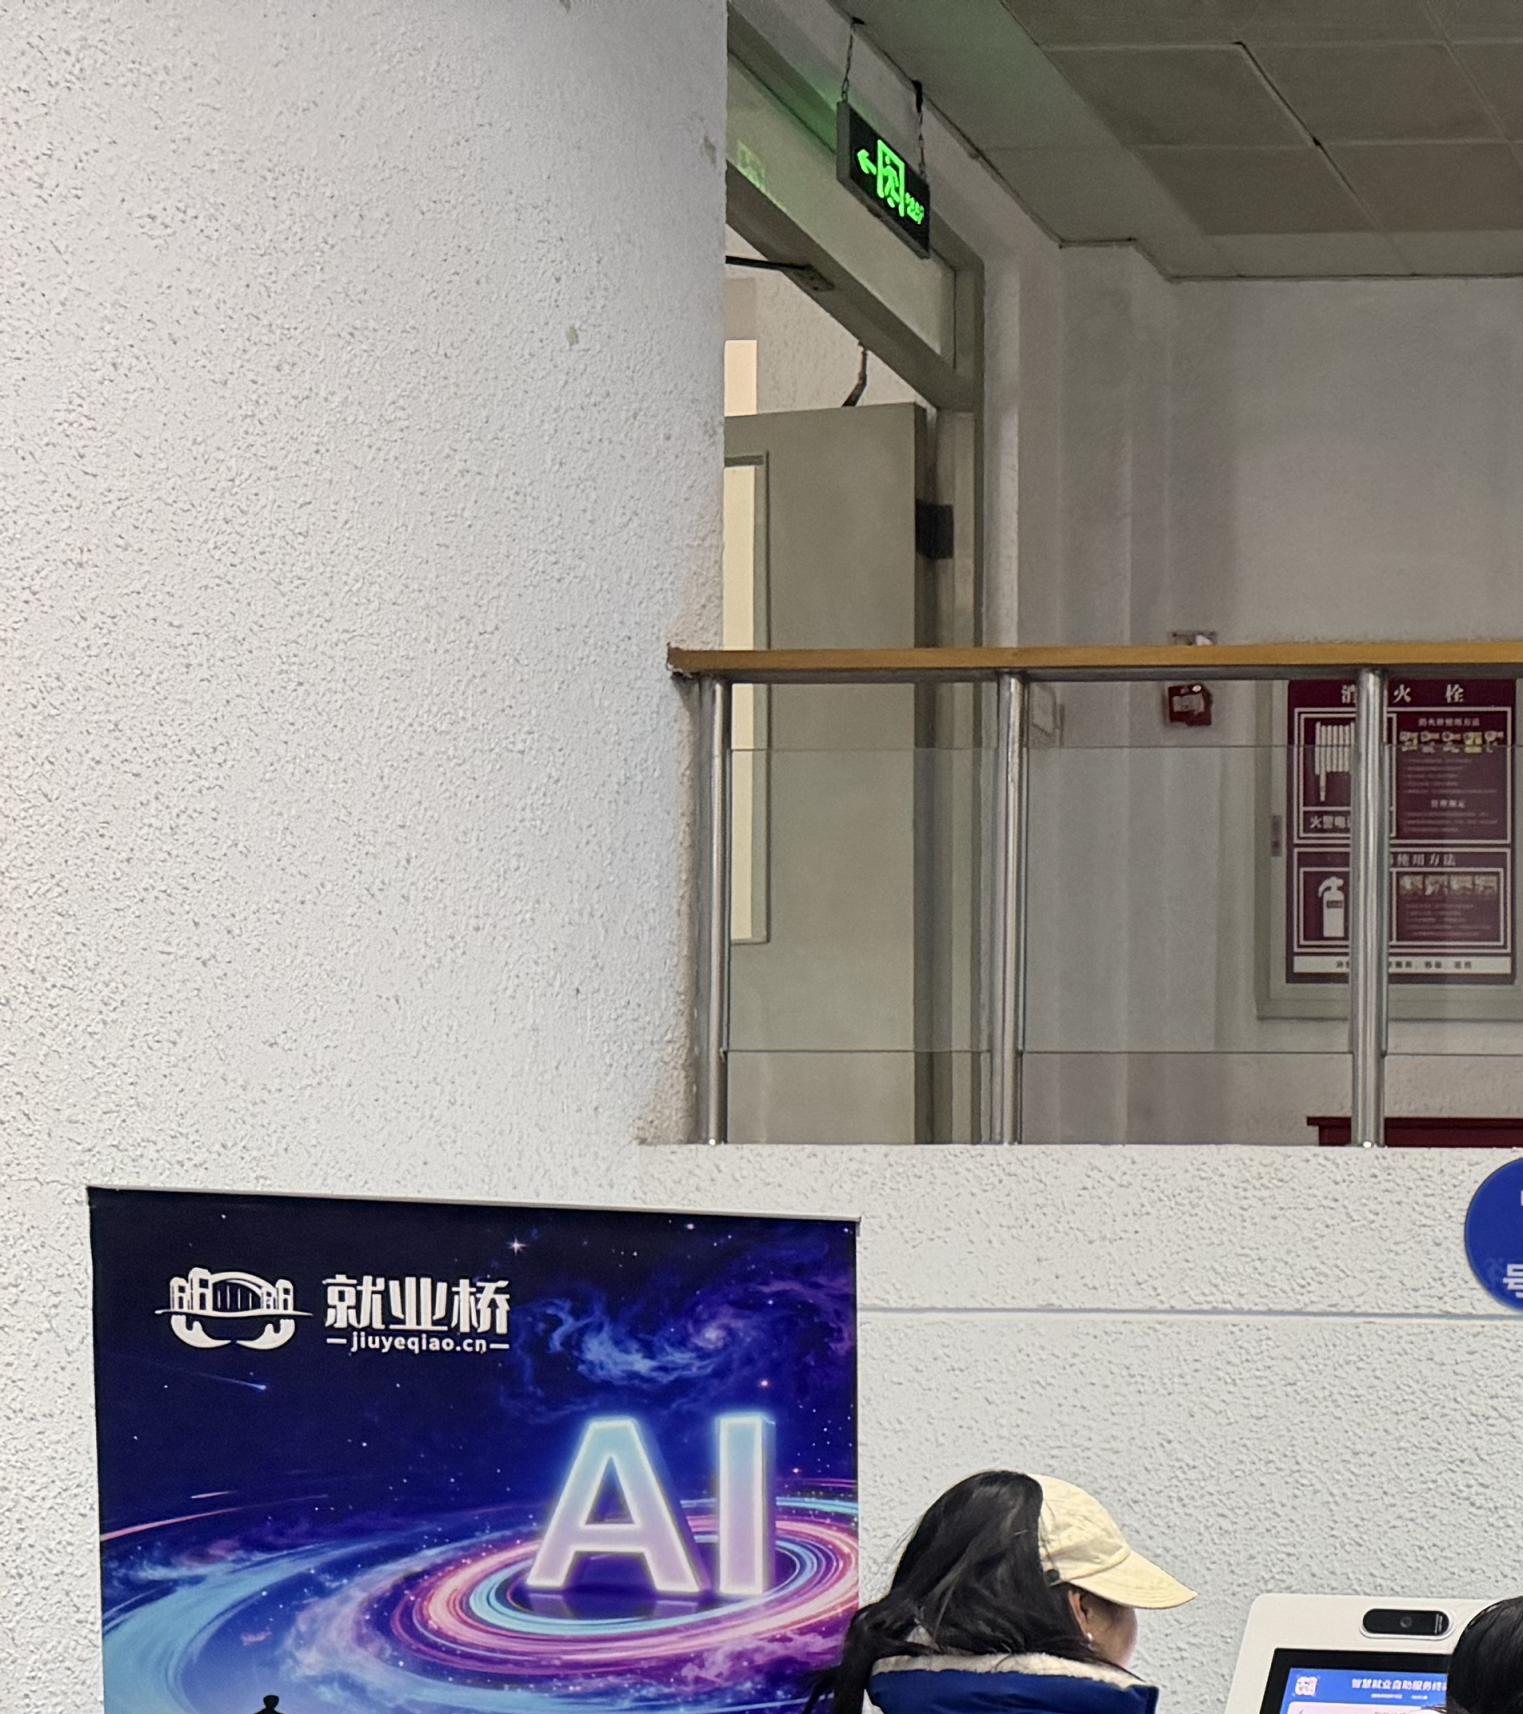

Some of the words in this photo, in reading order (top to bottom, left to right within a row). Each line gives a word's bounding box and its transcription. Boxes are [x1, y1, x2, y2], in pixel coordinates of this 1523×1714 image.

[1310, 815, 1350, 829] 火警电
[322, 1274, 511, 1334] 就业桥
[350, 1331, 487, 1353] jiuyeqiao.cn
[526, 1417, 768, 1595] AI
